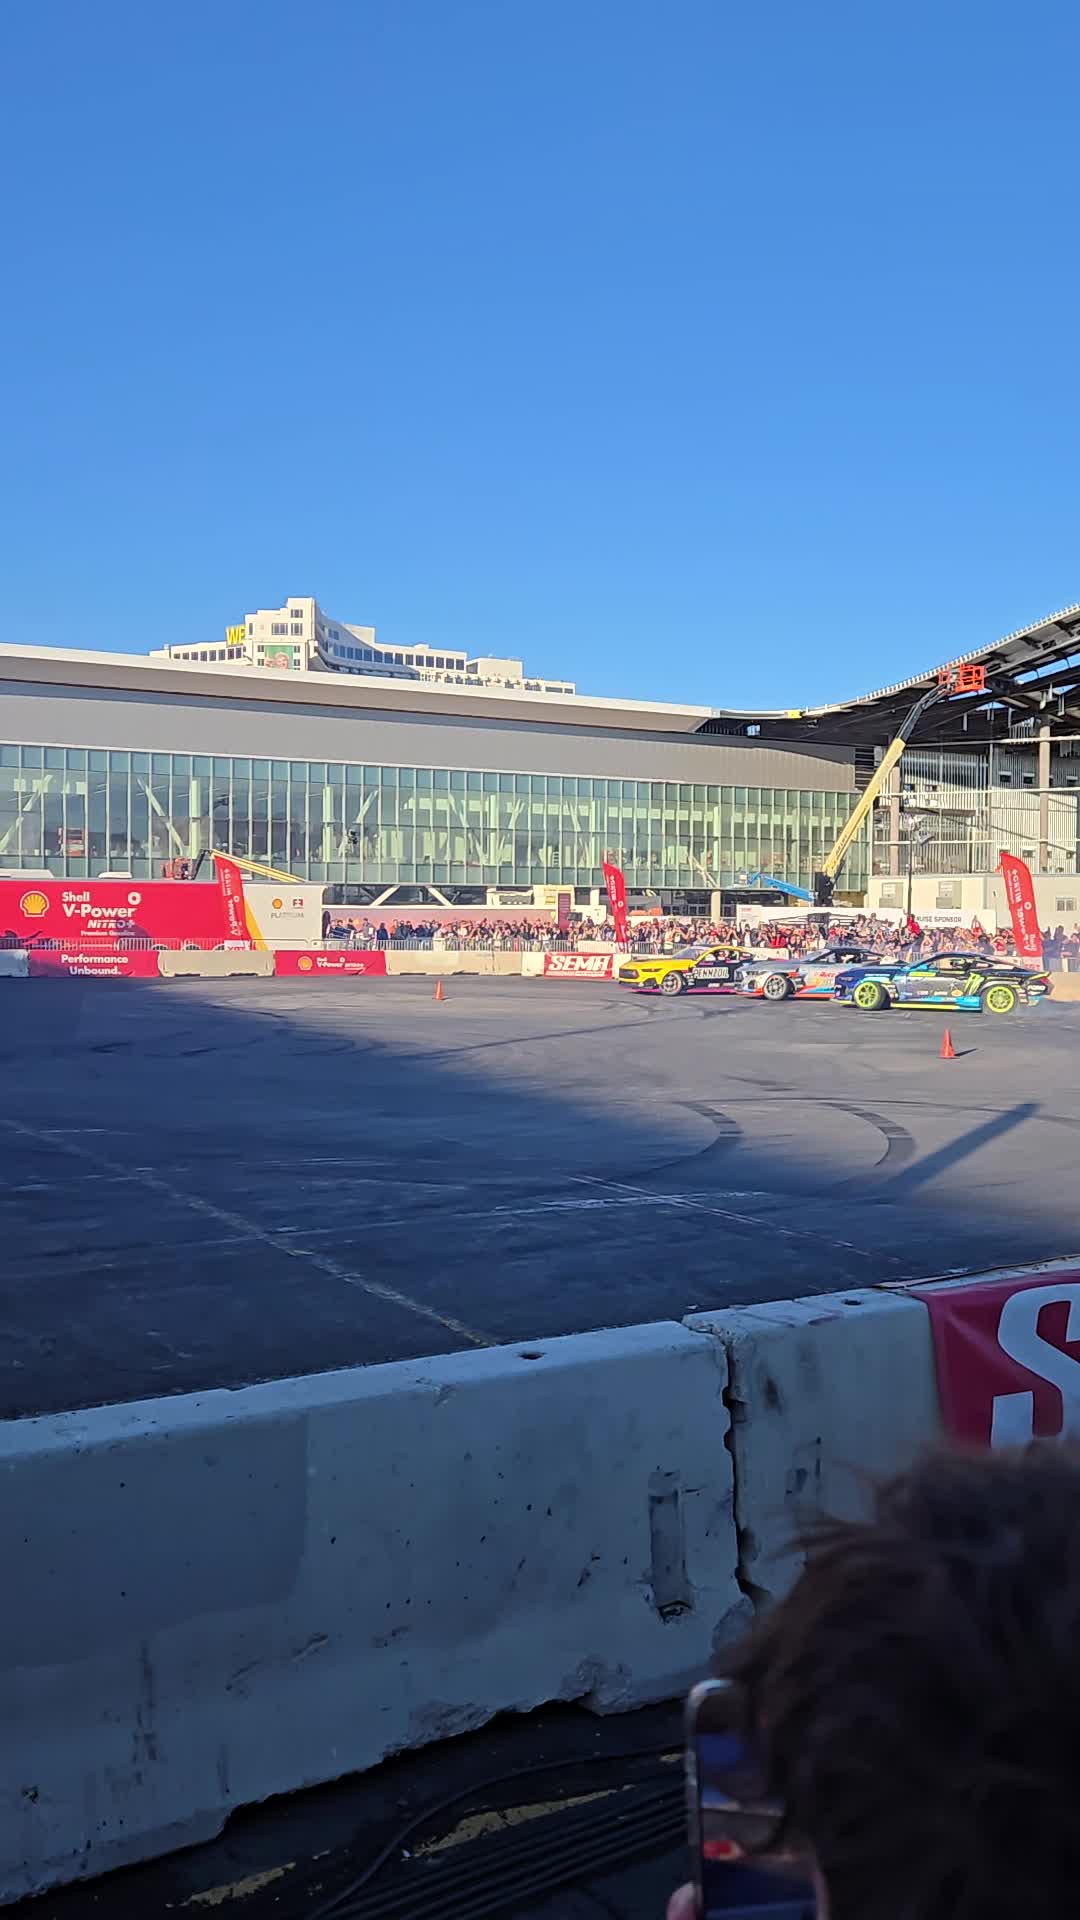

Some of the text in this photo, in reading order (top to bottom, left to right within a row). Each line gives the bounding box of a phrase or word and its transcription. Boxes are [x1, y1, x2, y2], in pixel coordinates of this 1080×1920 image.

[62, 891, 90, 902] Shell
[62, 903, 138, 918] V-Power
[61, 953, 129, 964] Performance
[548, 955, 611, 971] SEMA
[69, 965, 122, 976] Unbound.
